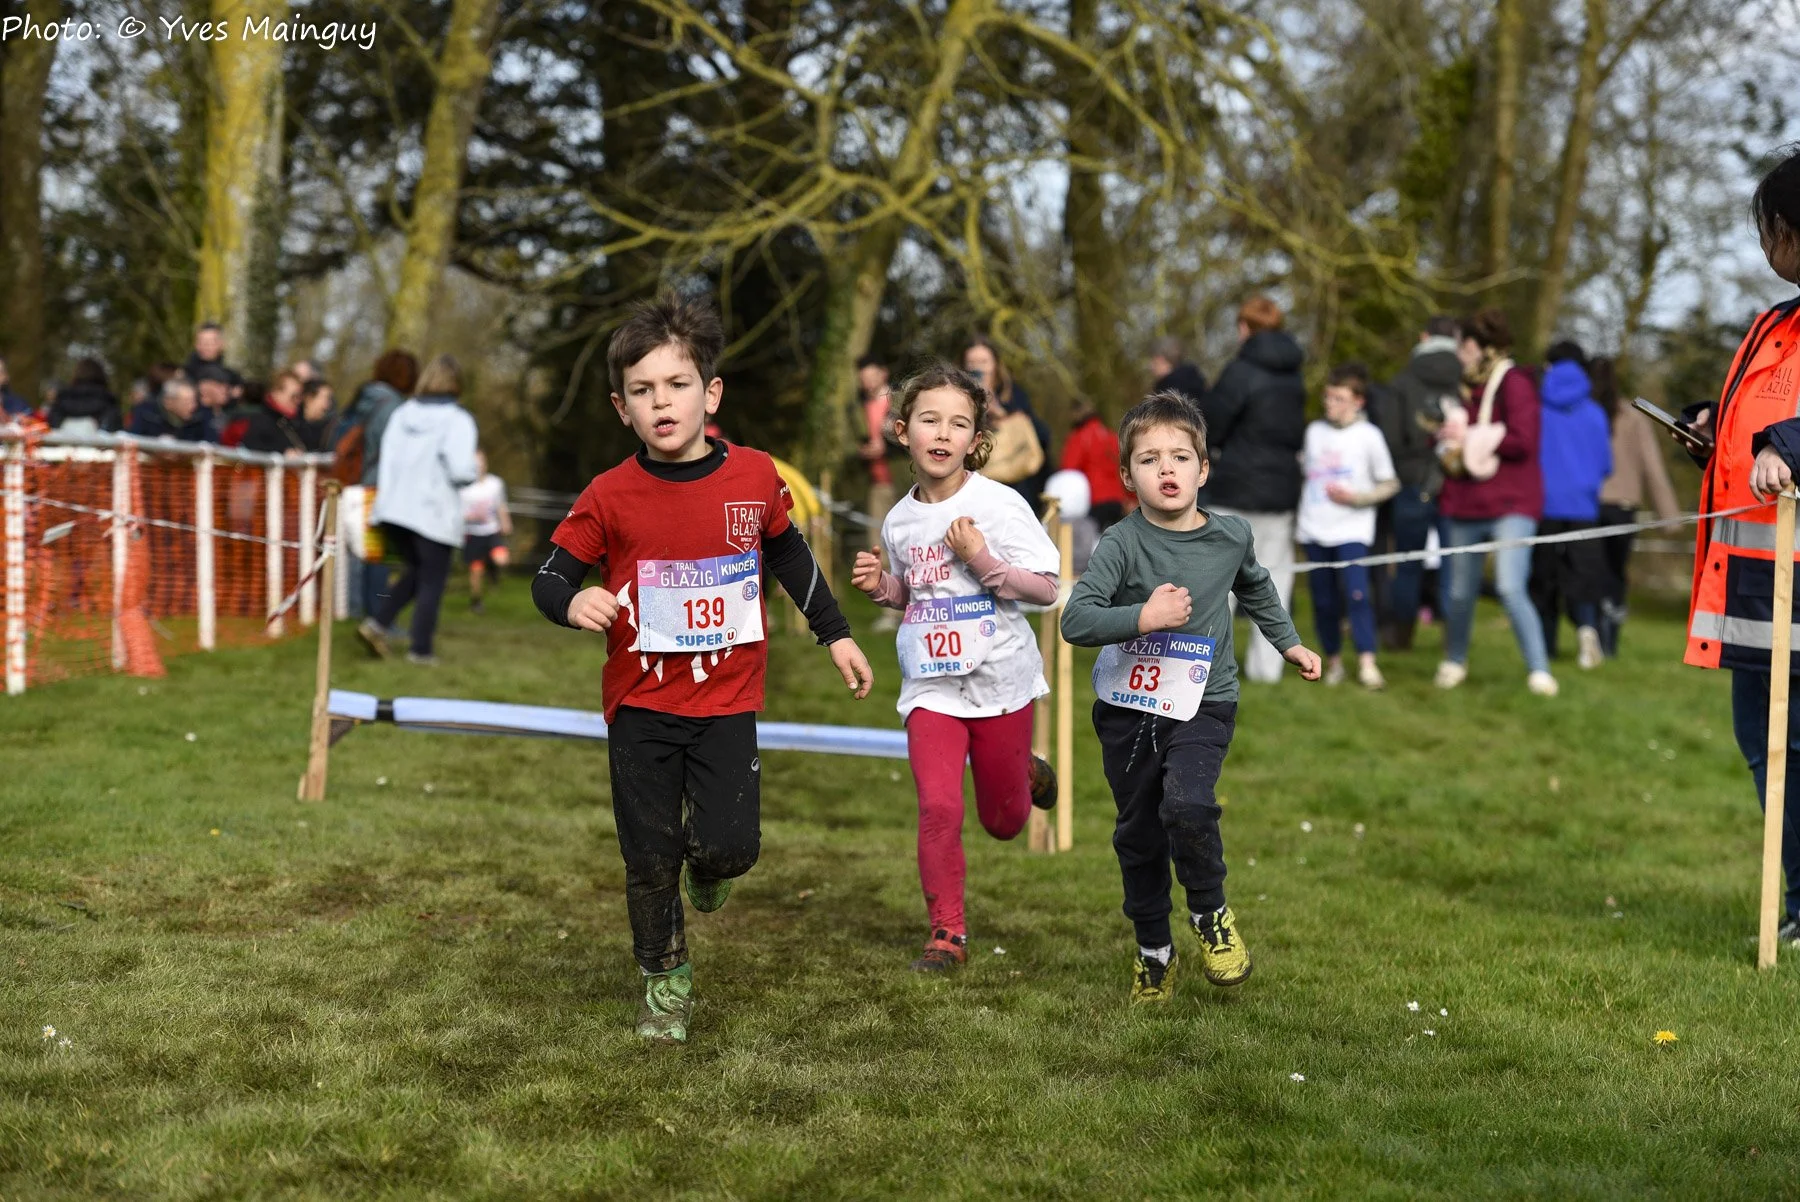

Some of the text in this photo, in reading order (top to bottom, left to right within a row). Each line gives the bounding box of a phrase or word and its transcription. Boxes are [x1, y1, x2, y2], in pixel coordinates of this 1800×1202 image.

[731, 507, 760, 523] TRAIL
[732, 523, 759, 536] GLAZIG
[910, 544, 946, 563] TRAIL
[675, 562, 697, 571] TRAIL
[721, 559, 756, 576] KINDER
[660, 571, 714, 587] GLAZIG
[683, 597, 725, 629] 139
[955, 600, 992, 614] KINDER
[911, 608, 949, 623] GLAZIG
[675, 633, 723, 647] SUPER
[924, 631, 962, 658] 120
[1170, 640, 1211, 656] KINDER
[921, 662, 961, 673] SUPER
[1128, 664, 1161, 692] 63
[1112, 691, 1158, 709] SUPER
